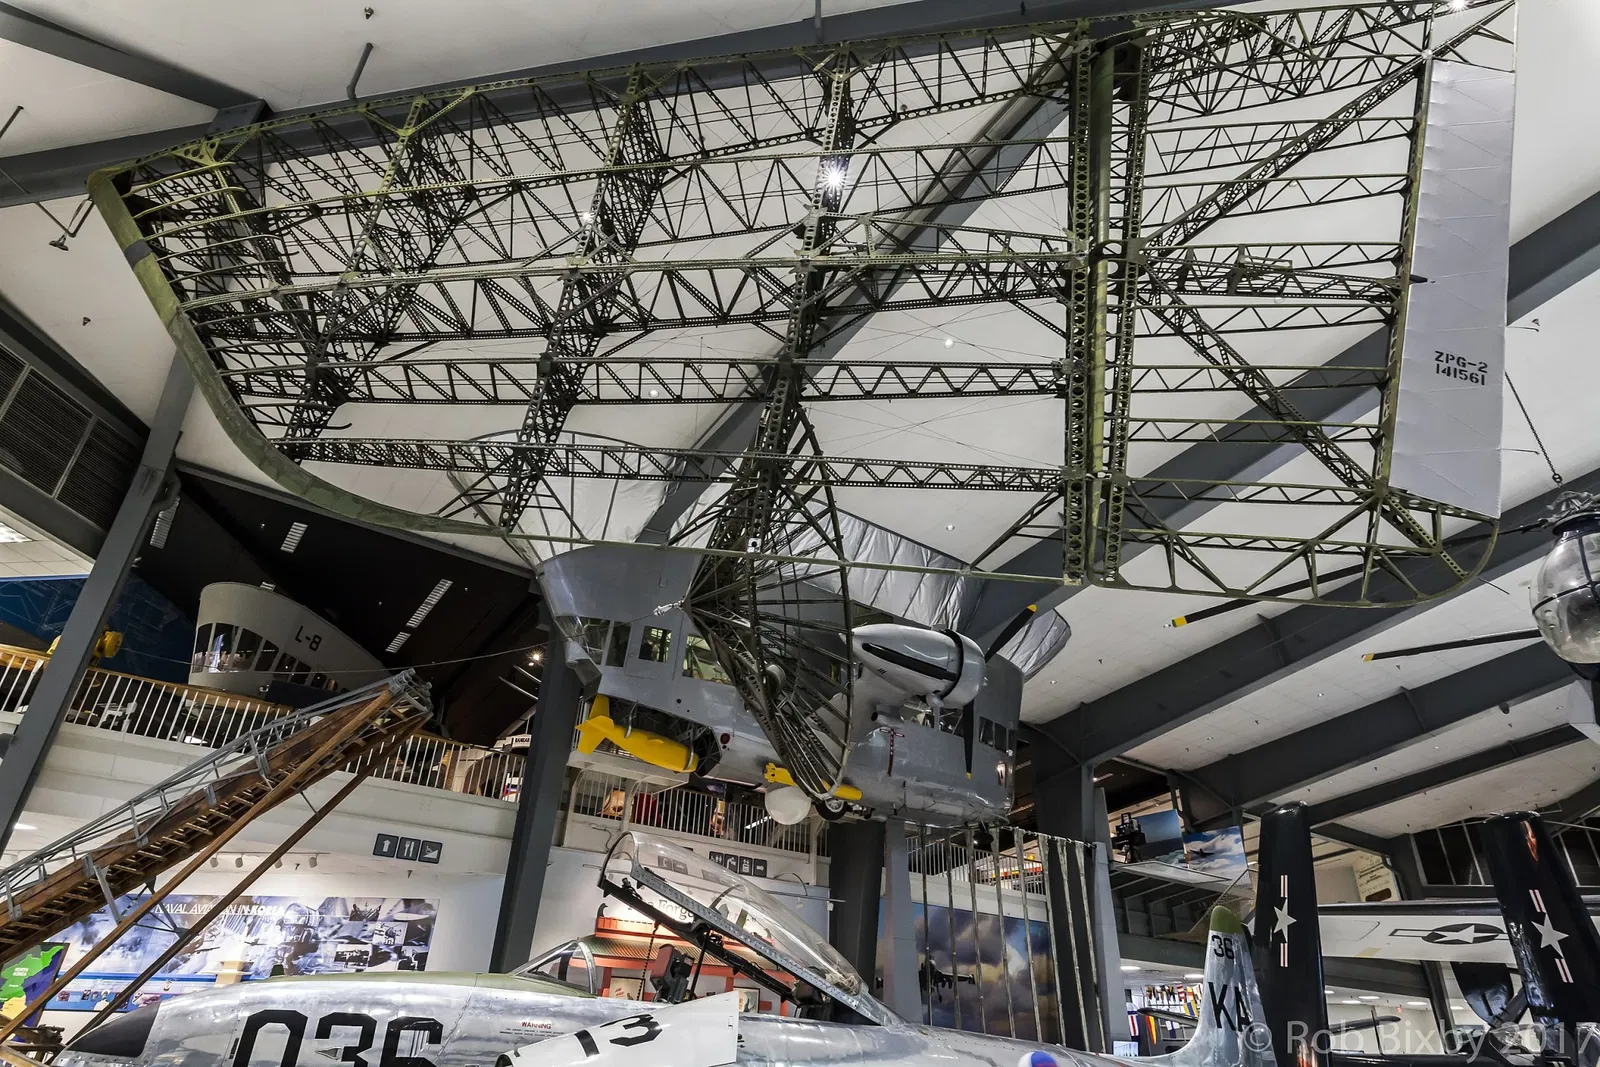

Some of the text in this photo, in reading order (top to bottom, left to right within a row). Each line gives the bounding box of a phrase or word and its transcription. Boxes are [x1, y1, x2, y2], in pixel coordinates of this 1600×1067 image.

[1435, 350, 1488, 373] ZPG-2
[1436, 363, 1485, 385] 141561
[295, 625, 322, 651] L-8
[155, 903, 188, 914] NAVAL
[1212, 934, 1235, 960] 36
[1208, 981, 1253, 1033] KA
[522, 1021, 552, 1030] WARNING
